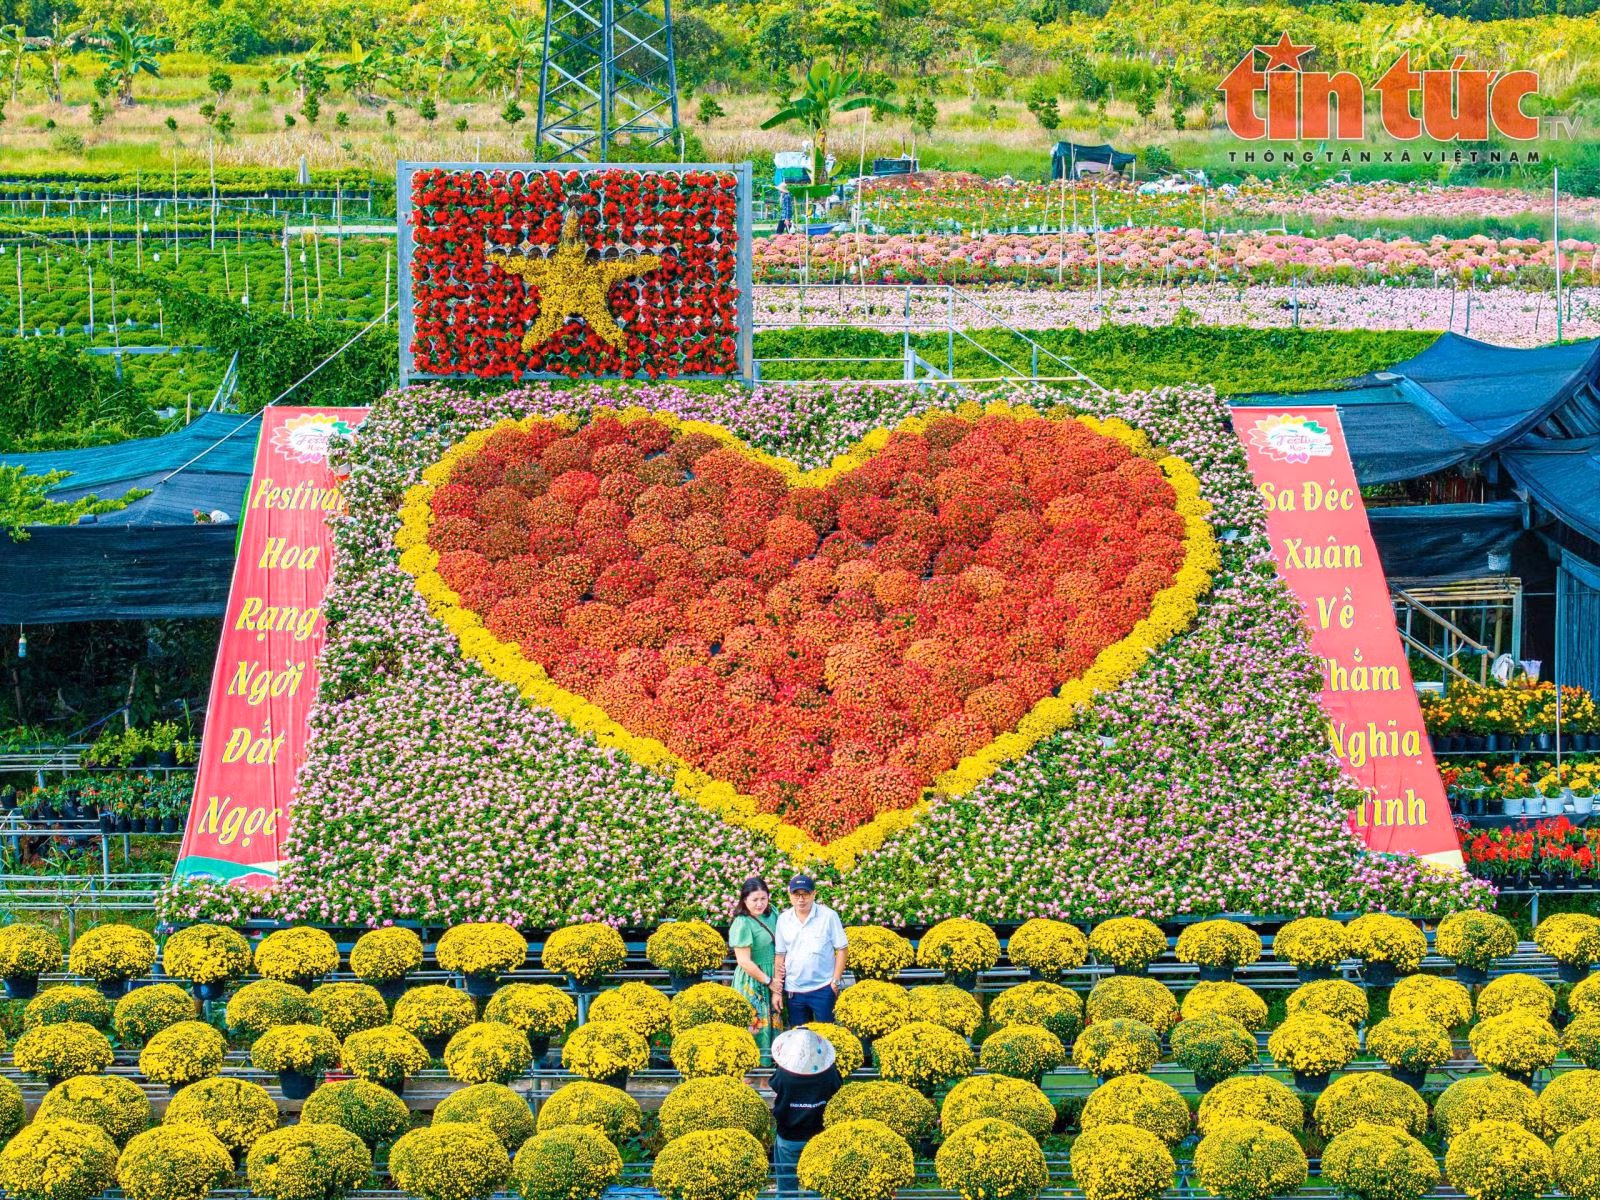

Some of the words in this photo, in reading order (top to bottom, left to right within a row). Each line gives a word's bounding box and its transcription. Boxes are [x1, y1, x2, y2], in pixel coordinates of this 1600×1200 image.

[1259, 481, 1296, 512] Sa
[1302, 478, 1354, 512] Đéc
[258, 537, 321, 570] Hoa
[1283, 535, 1363, 570] Xuân
[234, 597, 321, 641] Rạng
[1316, 587, 1355, 629] Về
[227, 659, 306, 706] Ngời
[221, 718, 286, 765] Đất
[197, 795, 283, 847] Ngọc
